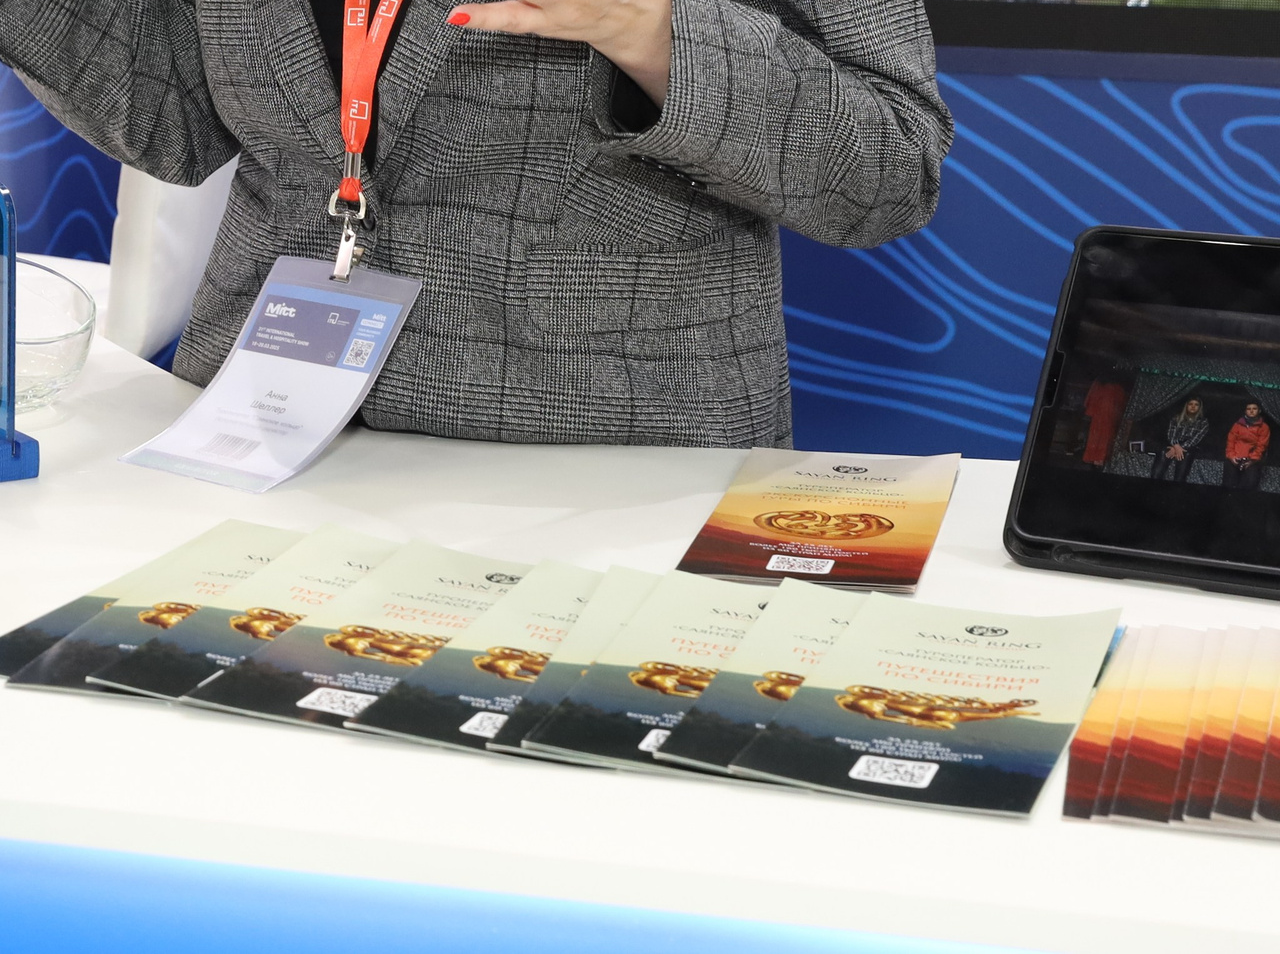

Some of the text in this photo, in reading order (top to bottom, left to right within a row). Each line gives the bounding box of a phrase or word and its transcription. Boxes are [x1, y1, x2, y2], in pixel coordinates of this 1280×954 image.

[265, 302, 297, 318] Mitt
[265, 390, 289, 402] Анна
[250, 400, 287, 415] Шеллер
[794, 470, 845, 480] SAYAN
[434, 576, 491, 591] SAYAN
[915, 631, 1043, 650] SAYAN RING
[876, 660, 1041, 685] ПУТЕШЕСТВИЯ
[884, 670, 1025, 692] ПО СИБИРИ
